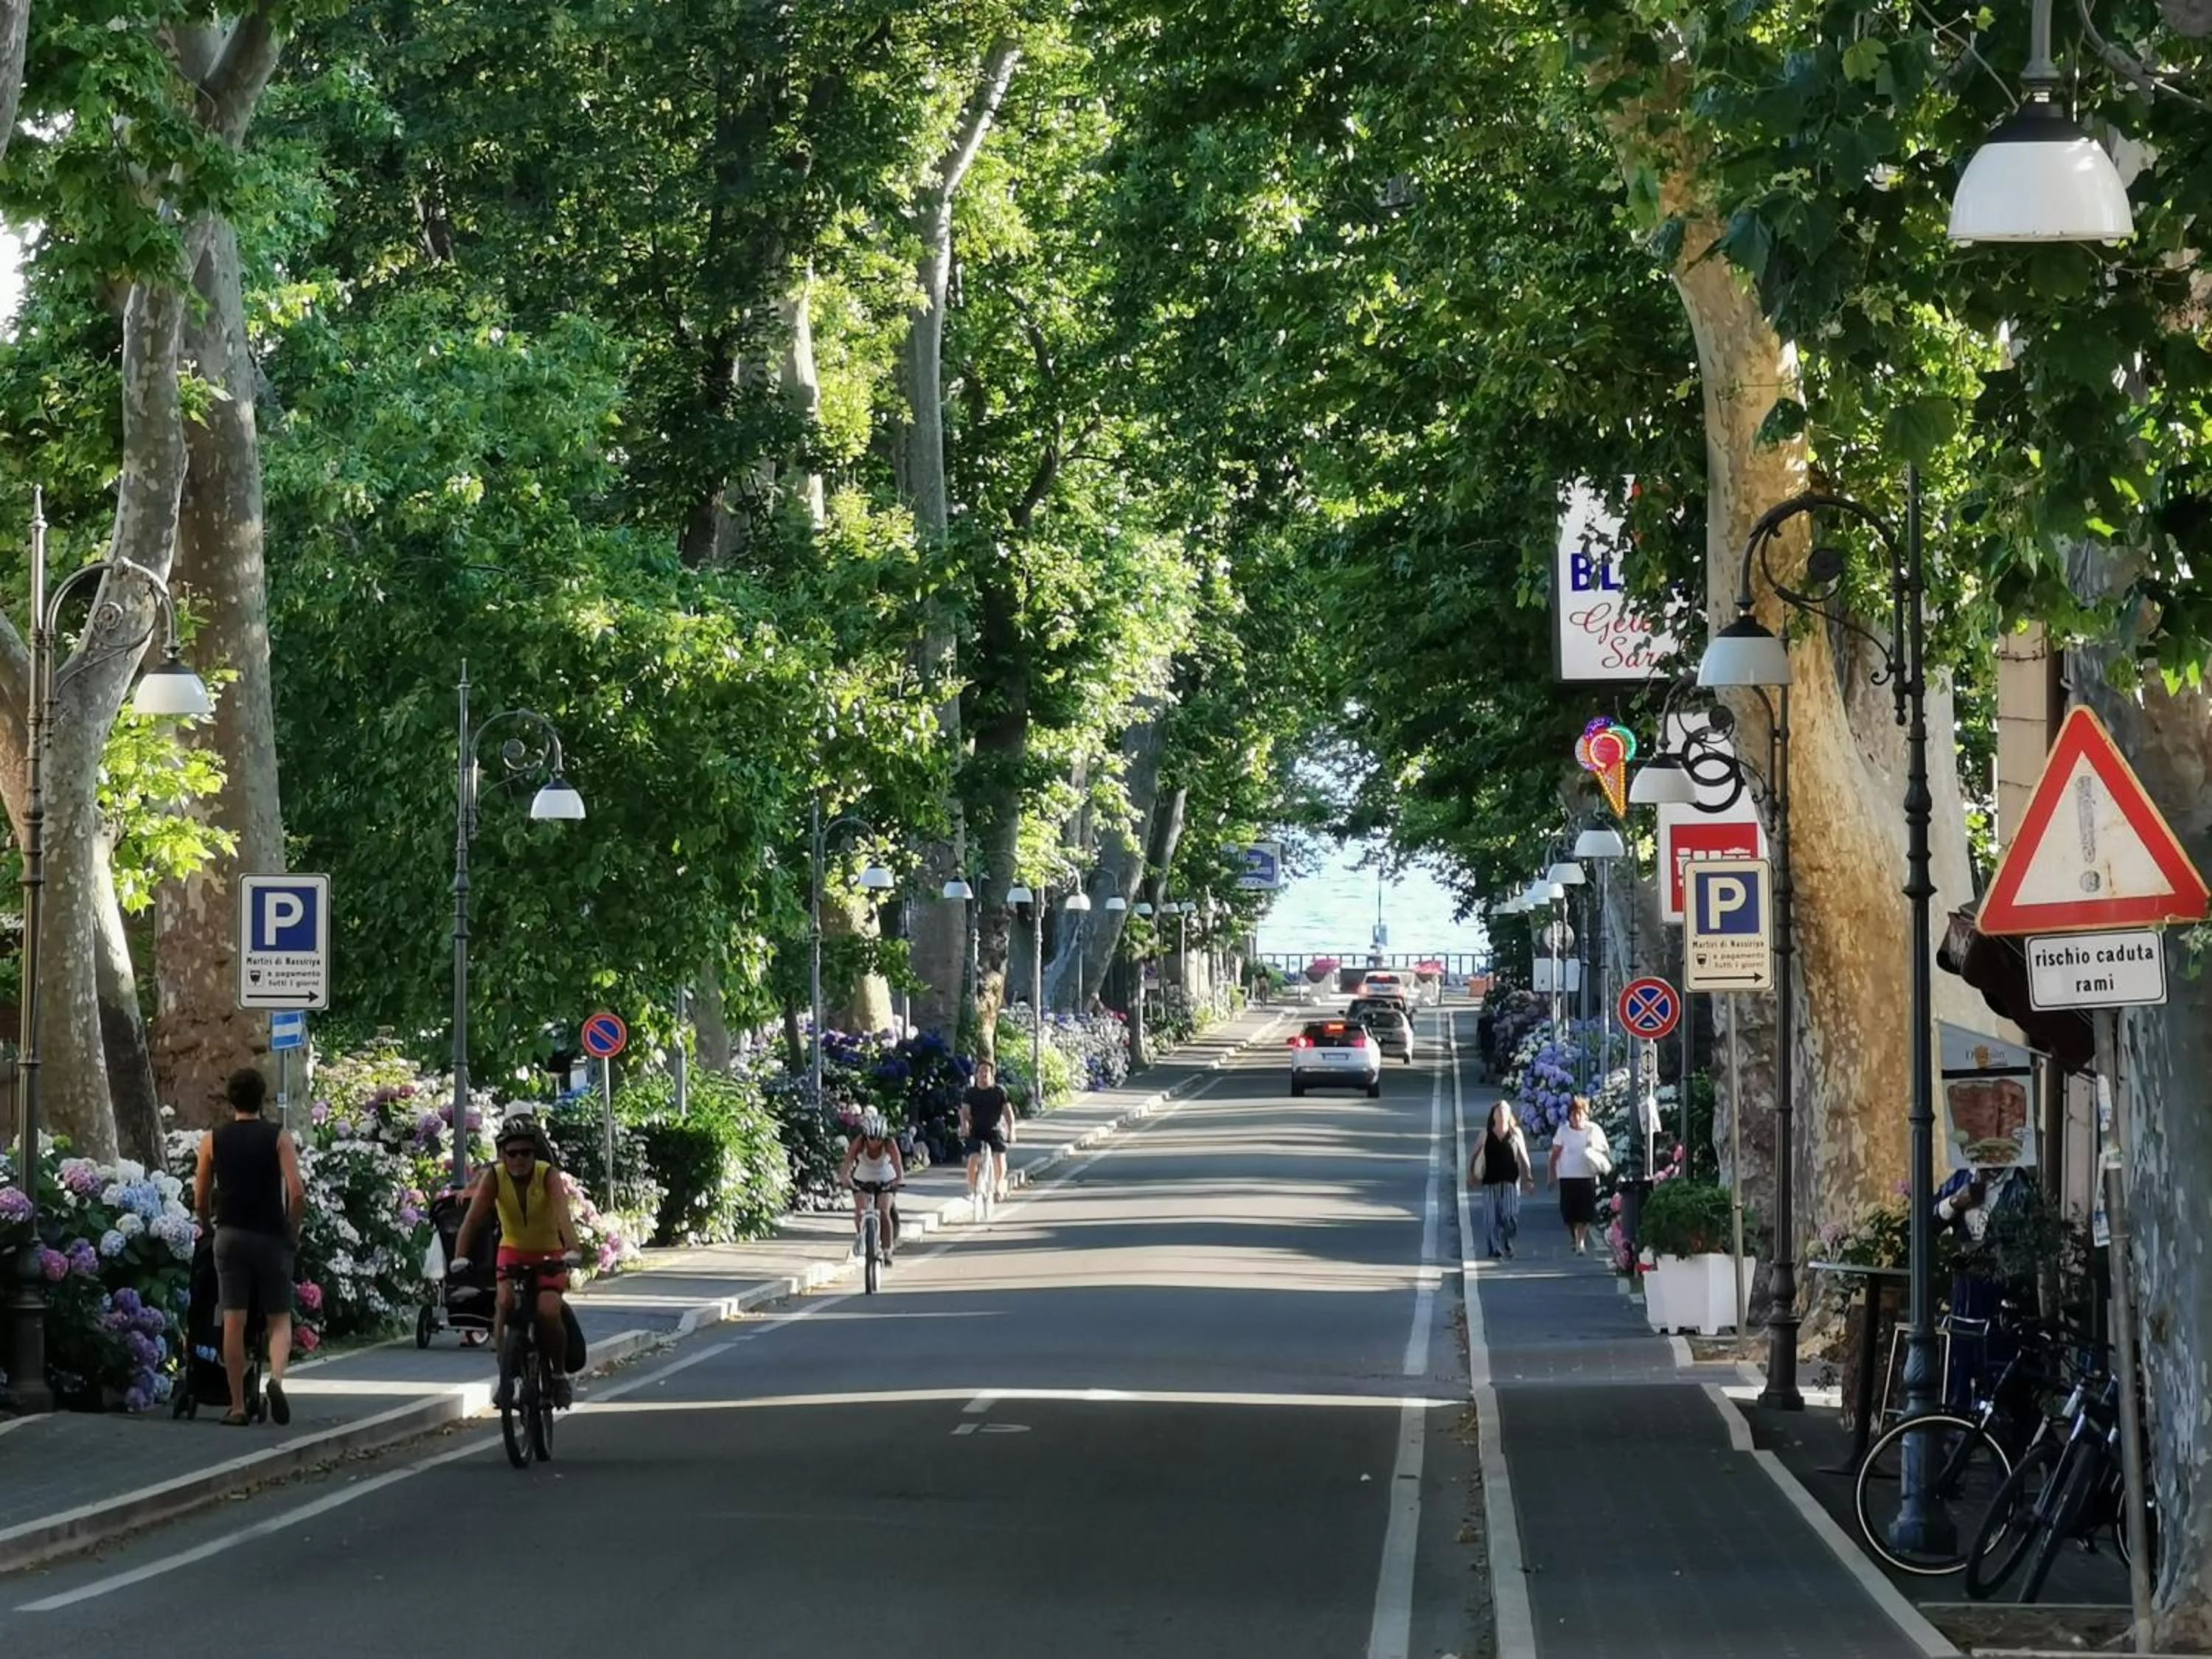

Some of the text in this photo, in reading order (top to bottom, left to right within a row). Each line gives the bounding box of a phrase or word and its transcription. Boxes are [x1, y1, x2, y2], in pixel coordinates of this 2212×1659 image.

[264, 891, 304, 946] P
[1707, 876, 1747, 930] P
[2035, 944, 2154, 967] rischio caduta
[2076, 973, 2114, 992] rami
